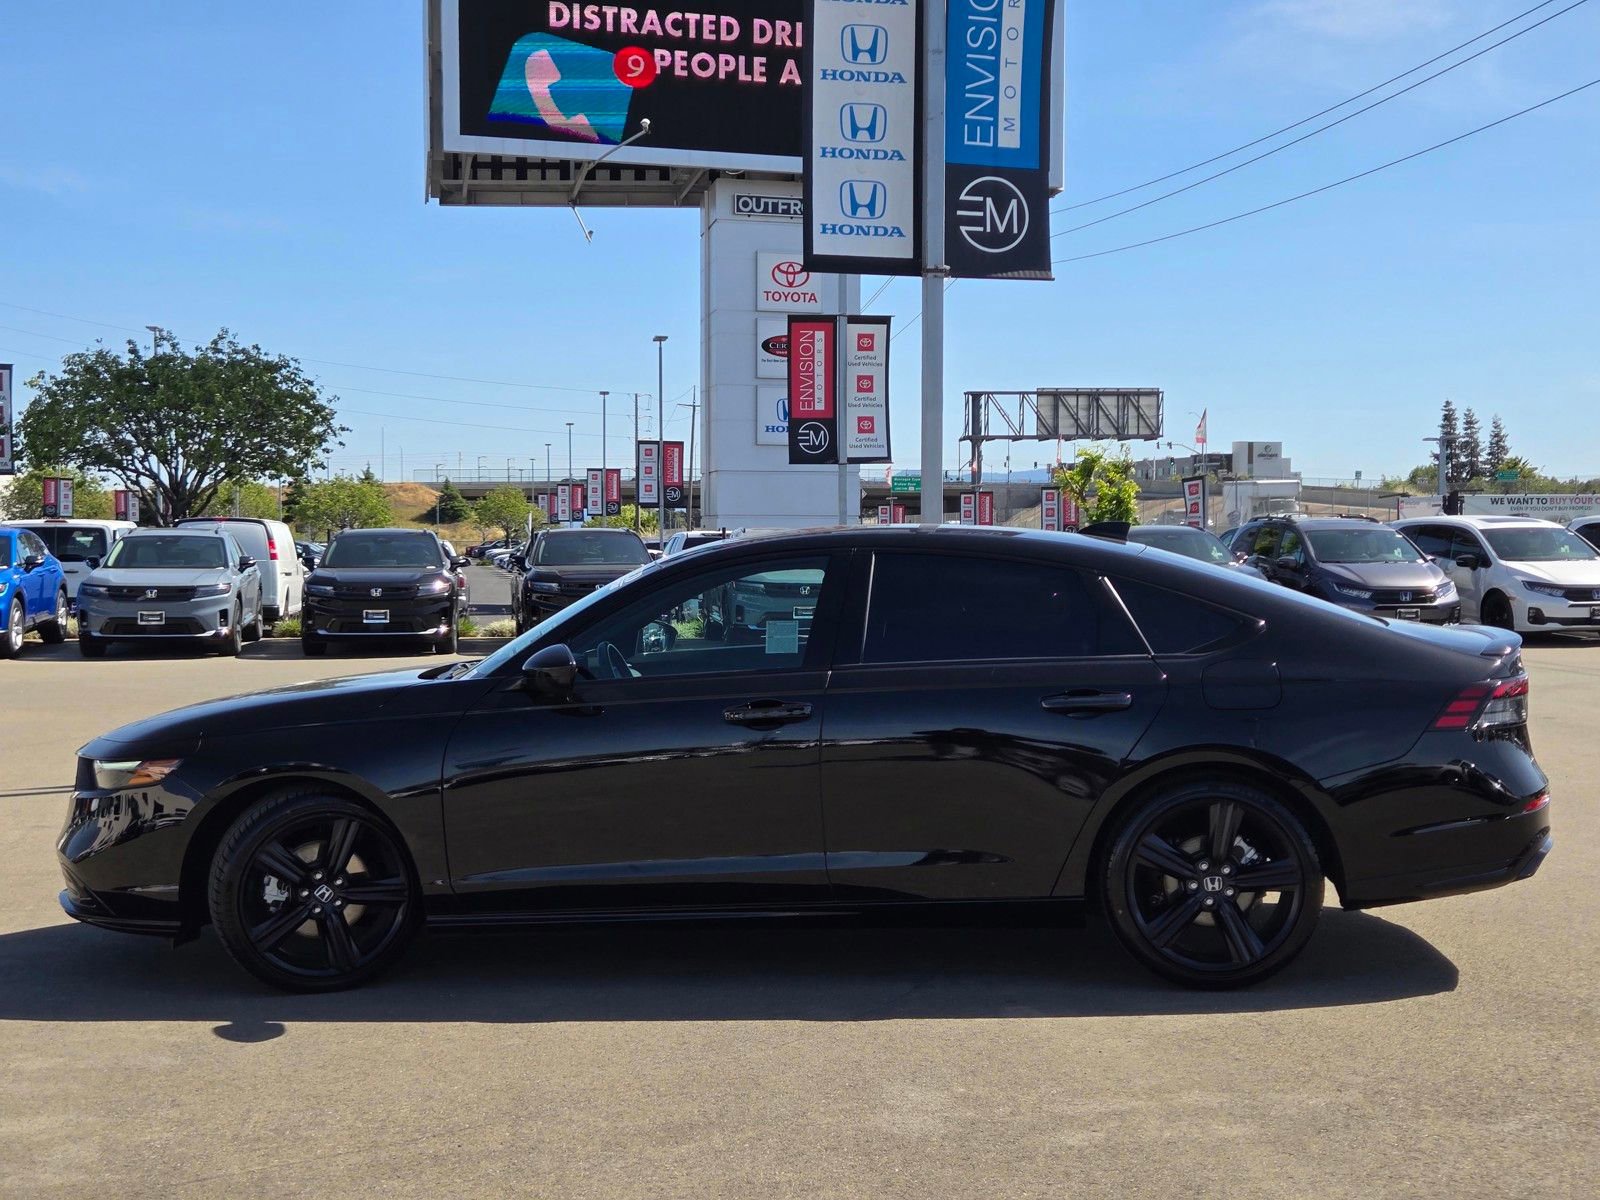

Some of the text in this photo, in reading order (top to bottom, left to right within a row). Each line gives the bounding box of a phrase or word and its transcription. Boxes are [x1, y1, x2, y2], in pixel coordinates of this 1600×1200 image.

[549, 1, 803, 48] DISTRACTED DRI
[626, 55, 645, 77] 9
[654, 48, 767, 83] PEOPLE
[820, 69, 907, 84] HONDA
[820, 146, 906, 161] HONDA
[738, 196, 803, 215] OUTFR
[820, 223, 906, 238] HONDA
[763, 290, 818, 303] TOYOTA
[799, 330, 814, 411] ENVISION
[1490, 497, 1505, 505] WE
[1507, 497, 1535, 505] WANT
[1536, 497, 1548, 505] TO
[1549, 497, 1567, 505] BUY
[1569, 497, 1593, 505] YOUR
